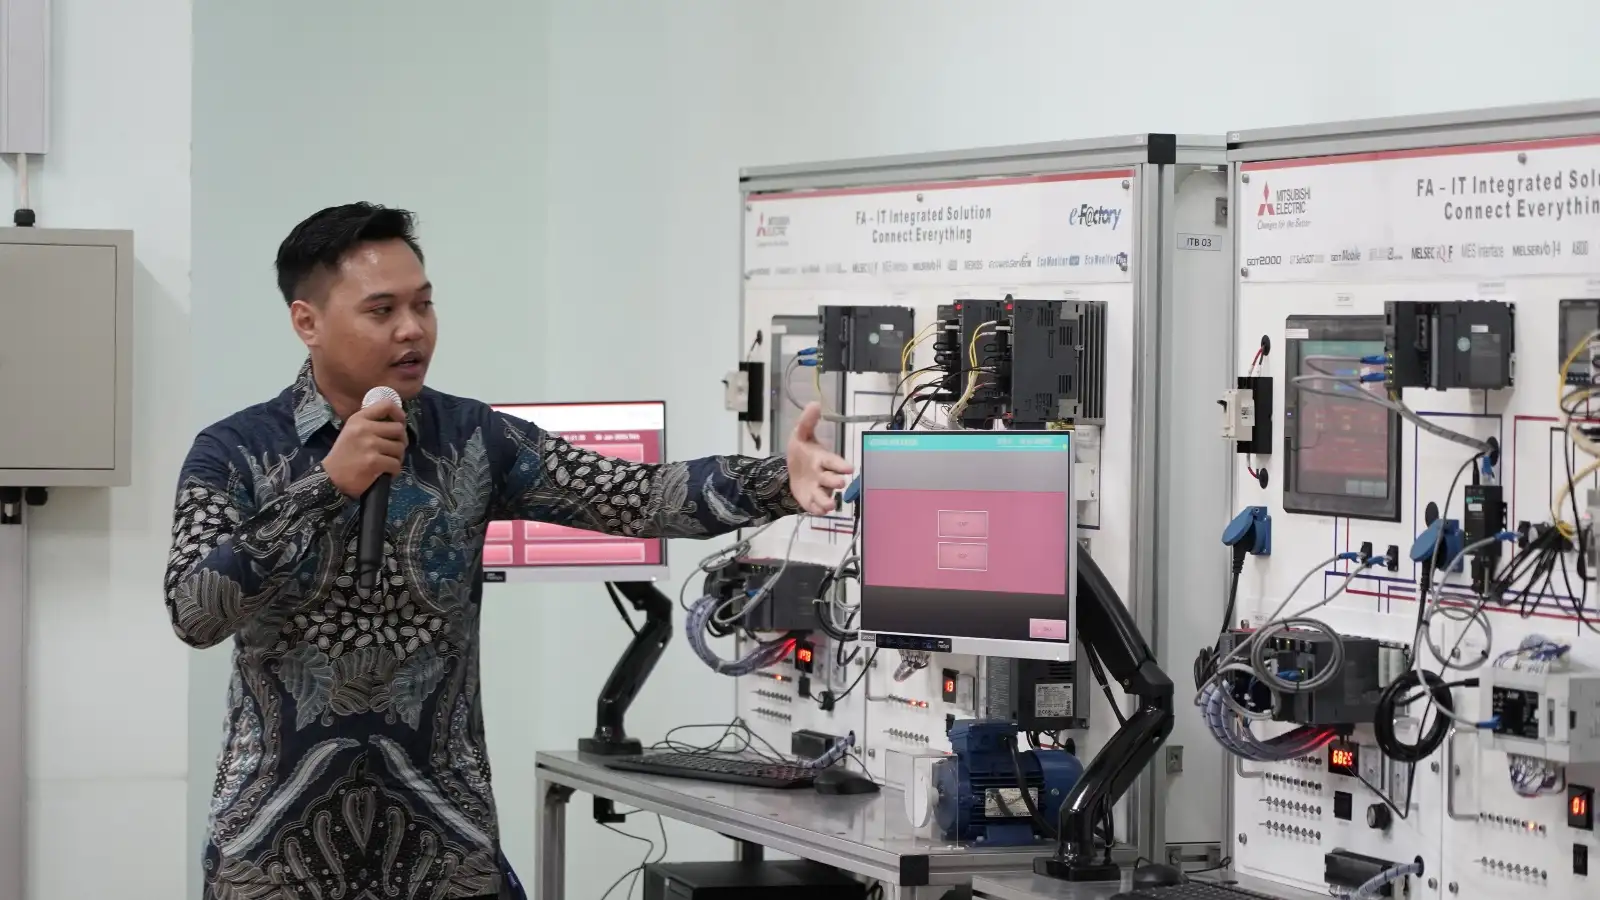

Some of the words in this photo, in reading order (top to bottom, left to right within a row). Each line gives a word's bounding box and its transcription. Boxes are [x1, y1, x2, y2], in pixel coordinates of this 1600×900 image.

[1416, 178, 1434, 197] FA
[1452, 176, 1467, 195] IT
[1473, 171, 1562, 198] Integrated
[1276, 187, 1311, 202] MITSUBISHI
[856, 210, 867, 225] FA
[877, 208, 886, 224] IT
[890, 206, 943, 226] Integrated
[947, 204, 992, 221] Solution
[1276, 201, 1306, 216] ELECTRIC
[1444, 201, 1511, 221] Connect
[872, 228, 913, 244] Connect
[916, 226, 972, 245] Everything
[1186, 237, 1200, 247] ITB
[1201, 238, 1212, 247] 03
[1411, 246, 1435, 260] MELSEC
[1246, 255, 1282, 267] GOT2000
